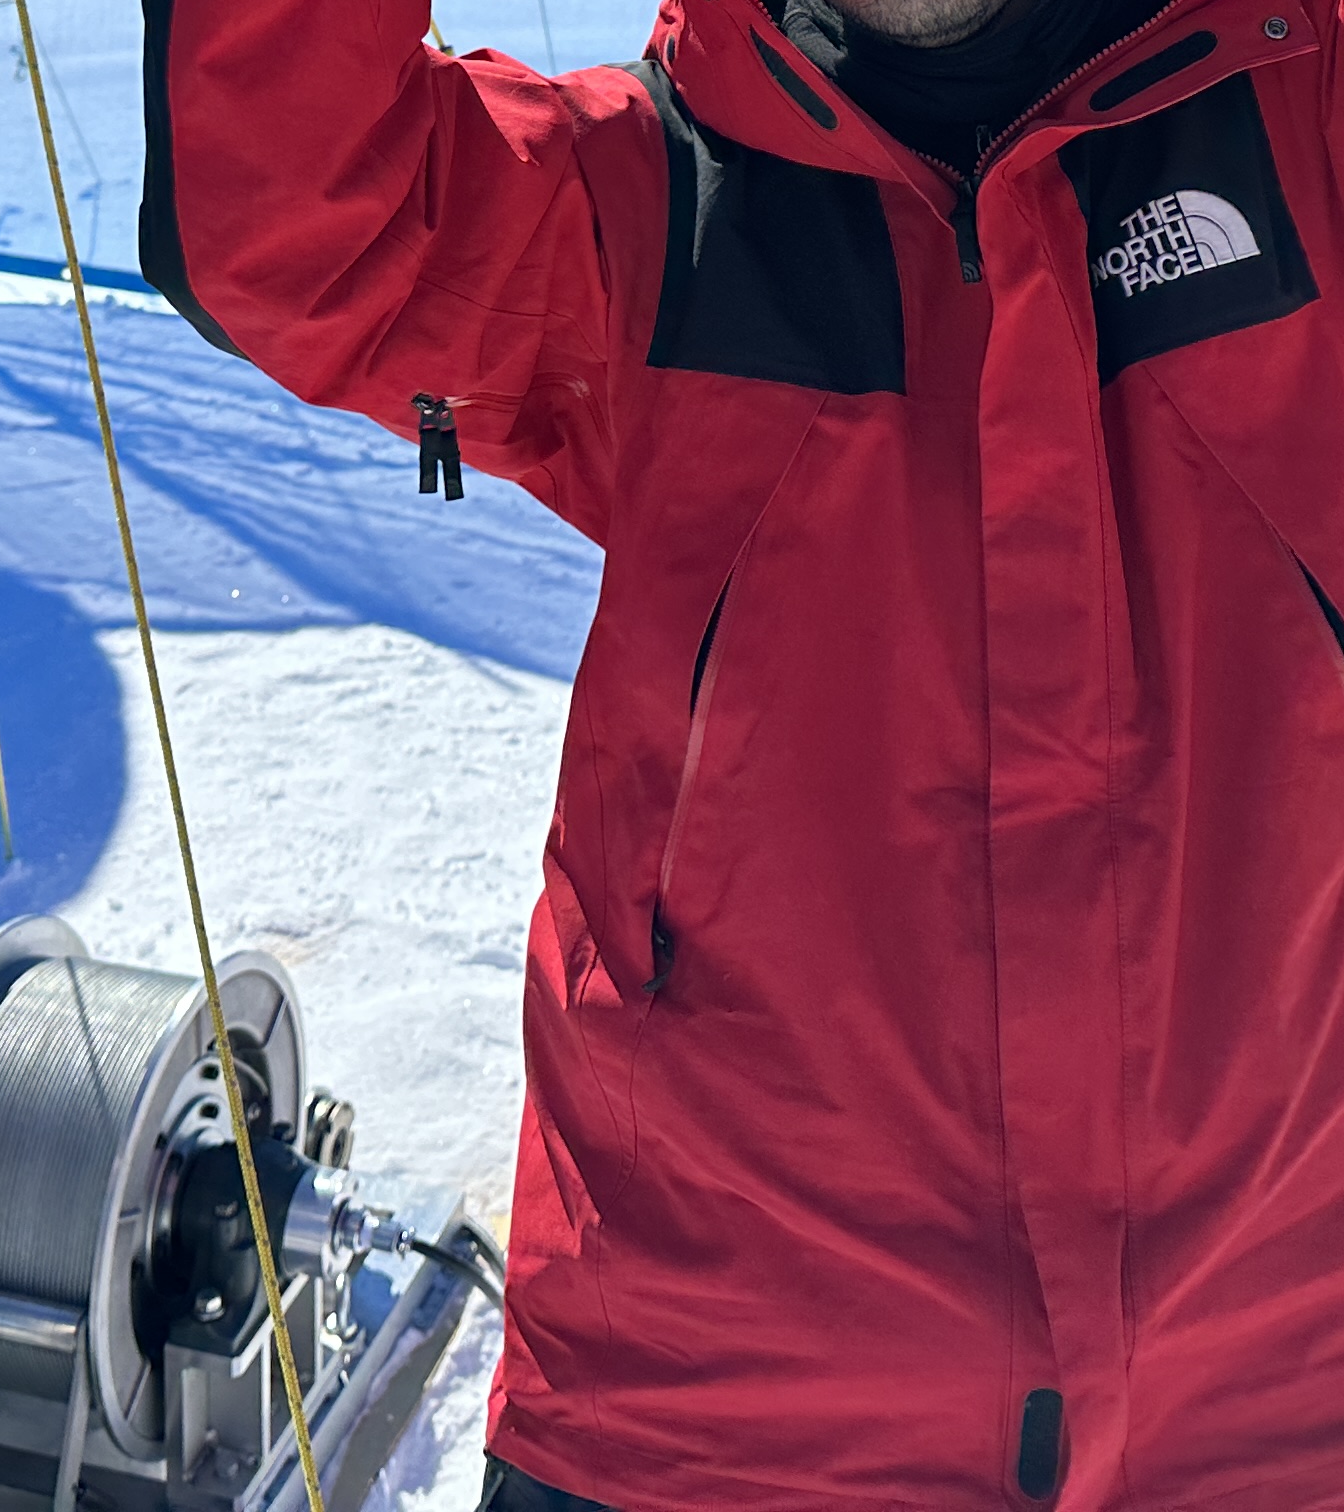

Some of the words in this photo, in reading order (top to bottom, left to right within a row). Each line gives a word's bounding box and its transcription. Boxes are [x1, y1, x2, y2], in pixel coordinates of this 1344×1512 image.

[1119, 193, 1184, 237] THE
[1091, 218, 1193, 288] NORTH
[1119, 246, 1204, 298] FACE
